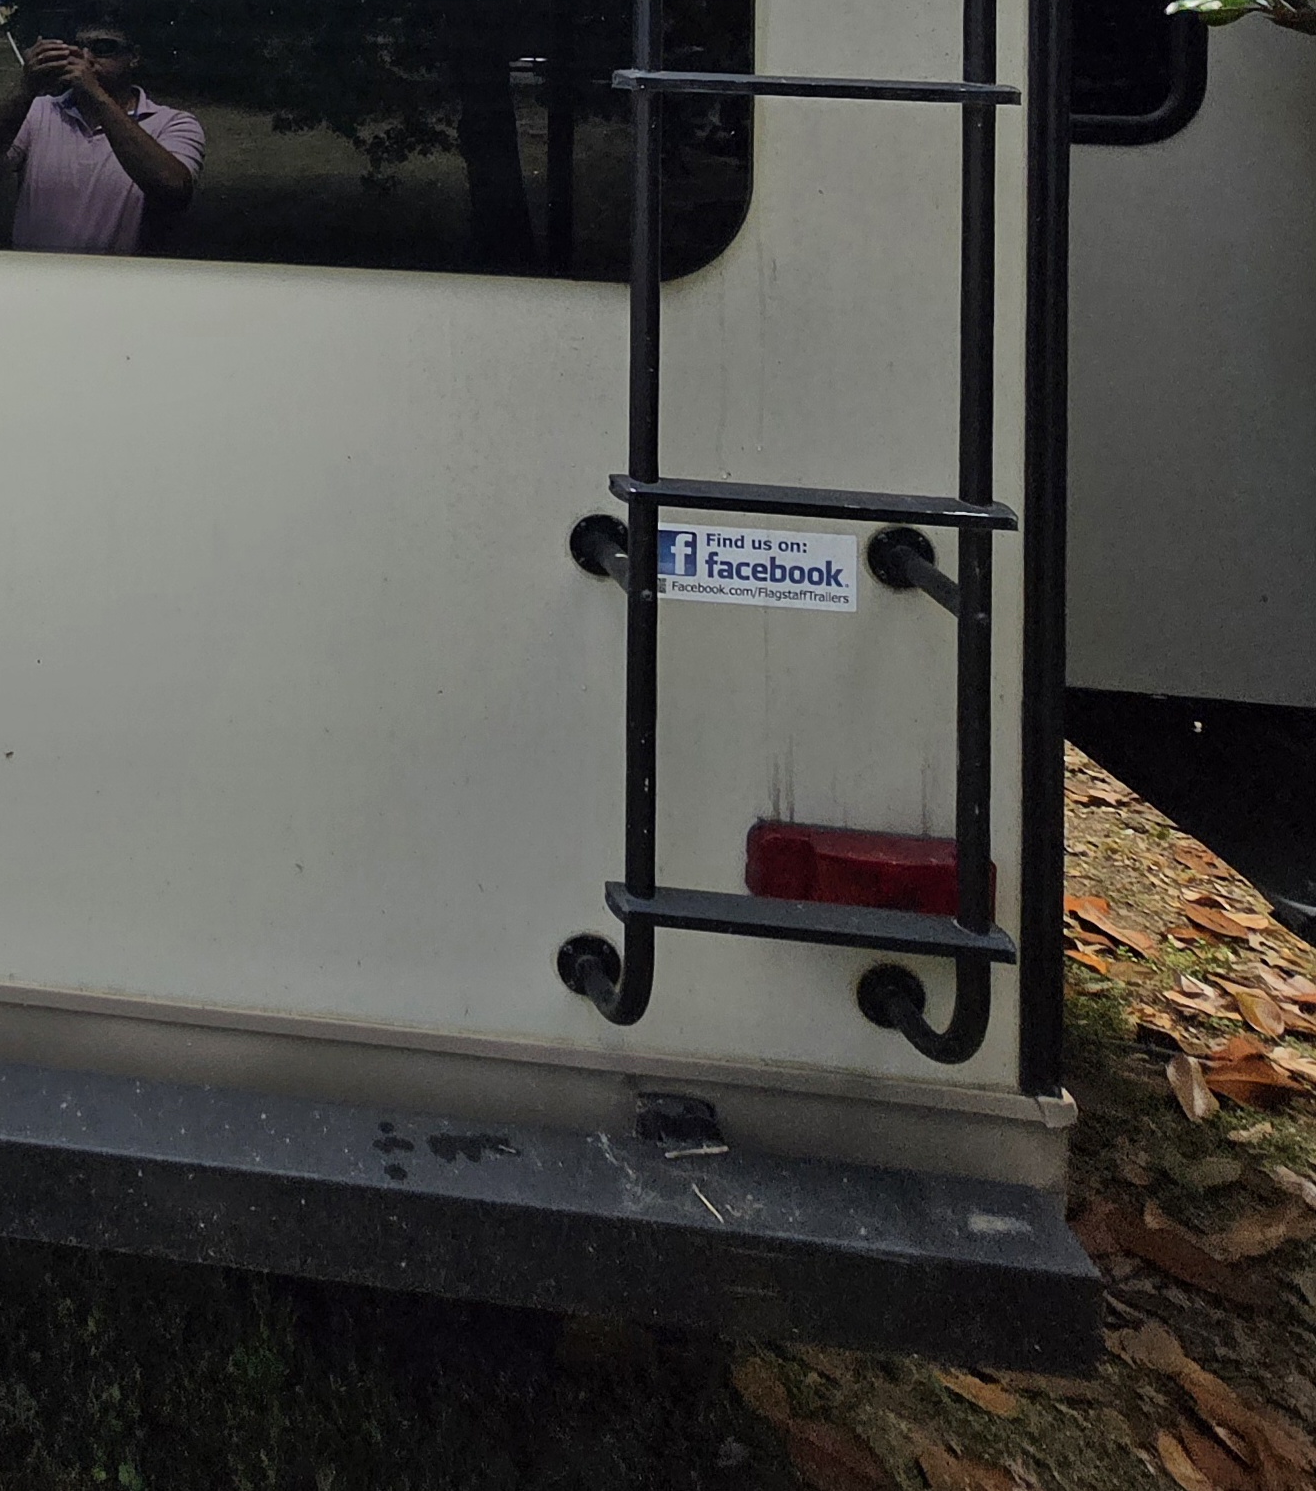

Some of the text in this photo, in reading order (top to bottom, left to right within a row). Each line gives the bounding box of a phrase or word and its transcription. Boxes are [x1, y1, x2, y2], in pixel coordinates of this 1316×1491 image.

[705, 532, 808, 553] Find us on:
[671, 581, 850, 604] Facebook.com/FlagstaffTrailers
